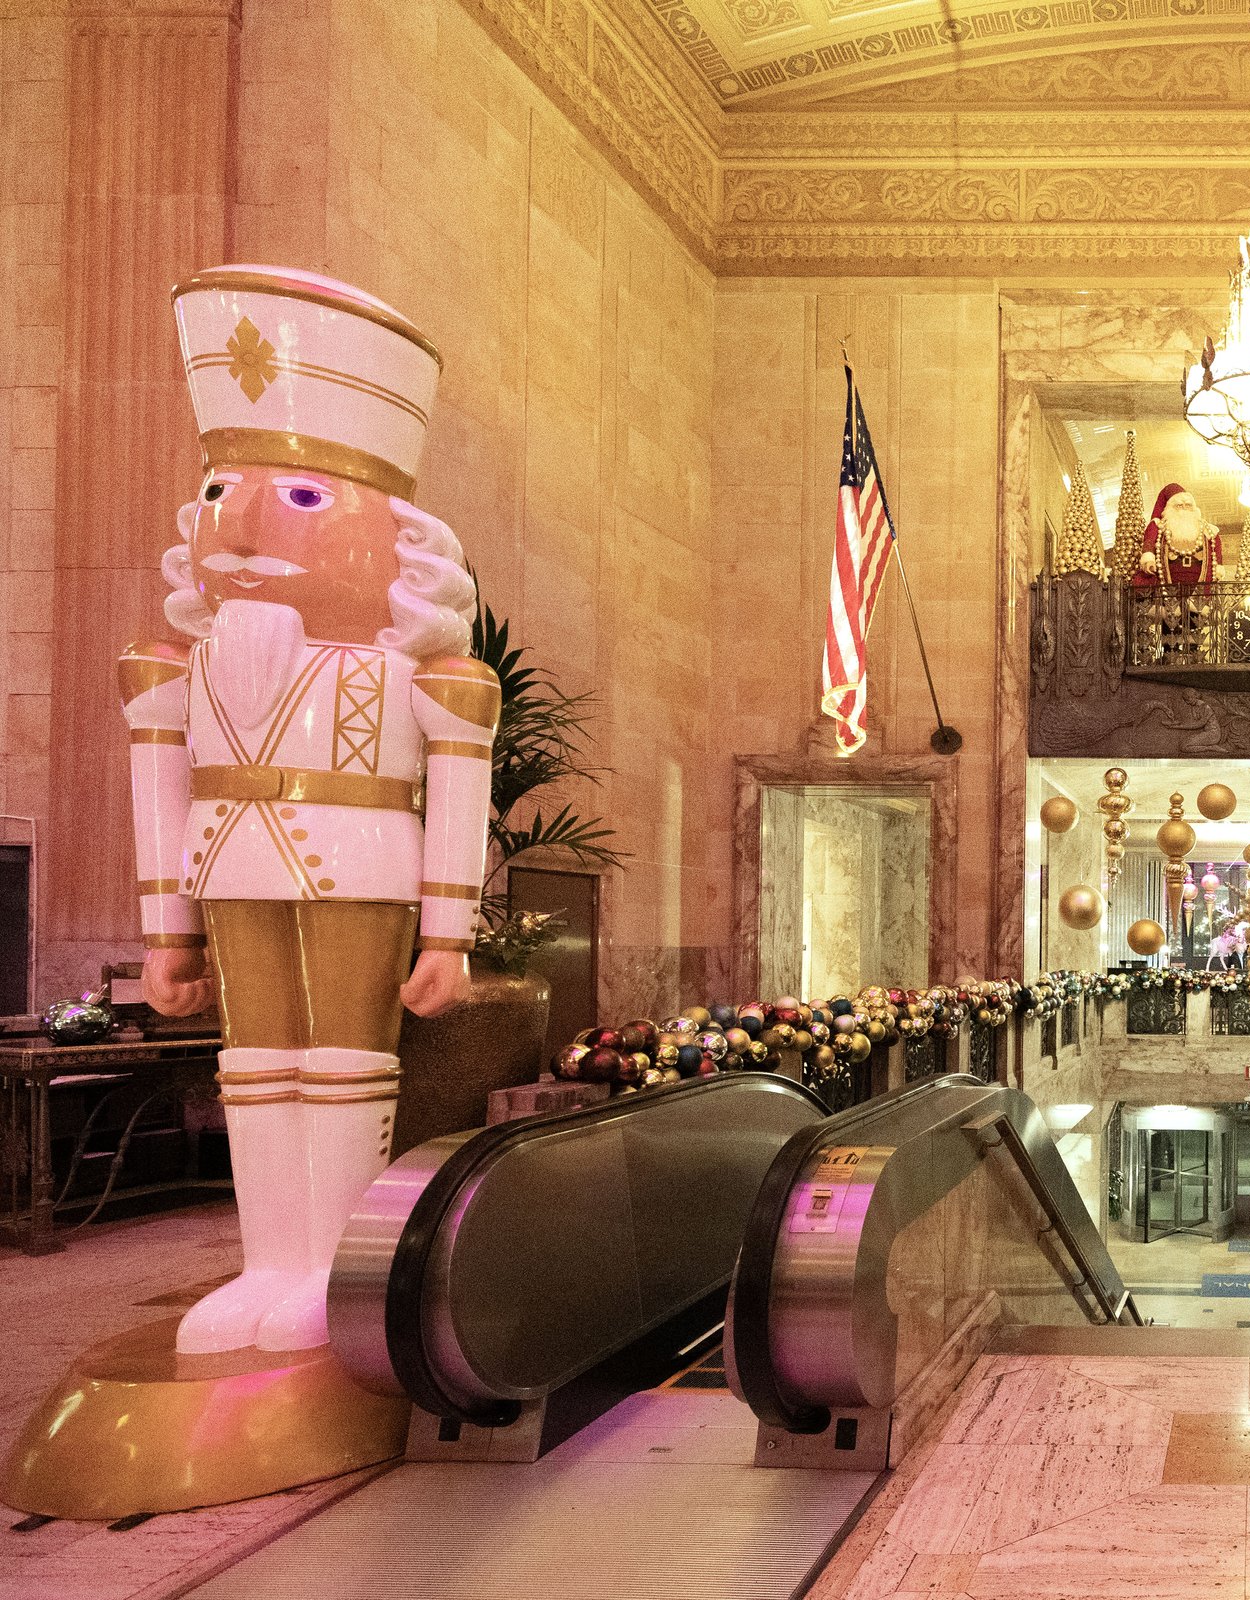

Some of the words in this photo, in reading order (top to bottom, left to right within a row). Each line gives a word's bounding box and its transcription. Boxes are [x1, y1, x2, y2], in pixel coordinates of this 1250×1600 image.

[1235, 610, 1245, 619] 10
[1234, 621, 1240, 629] 9
[1236, 631, 1244, 640] 8
